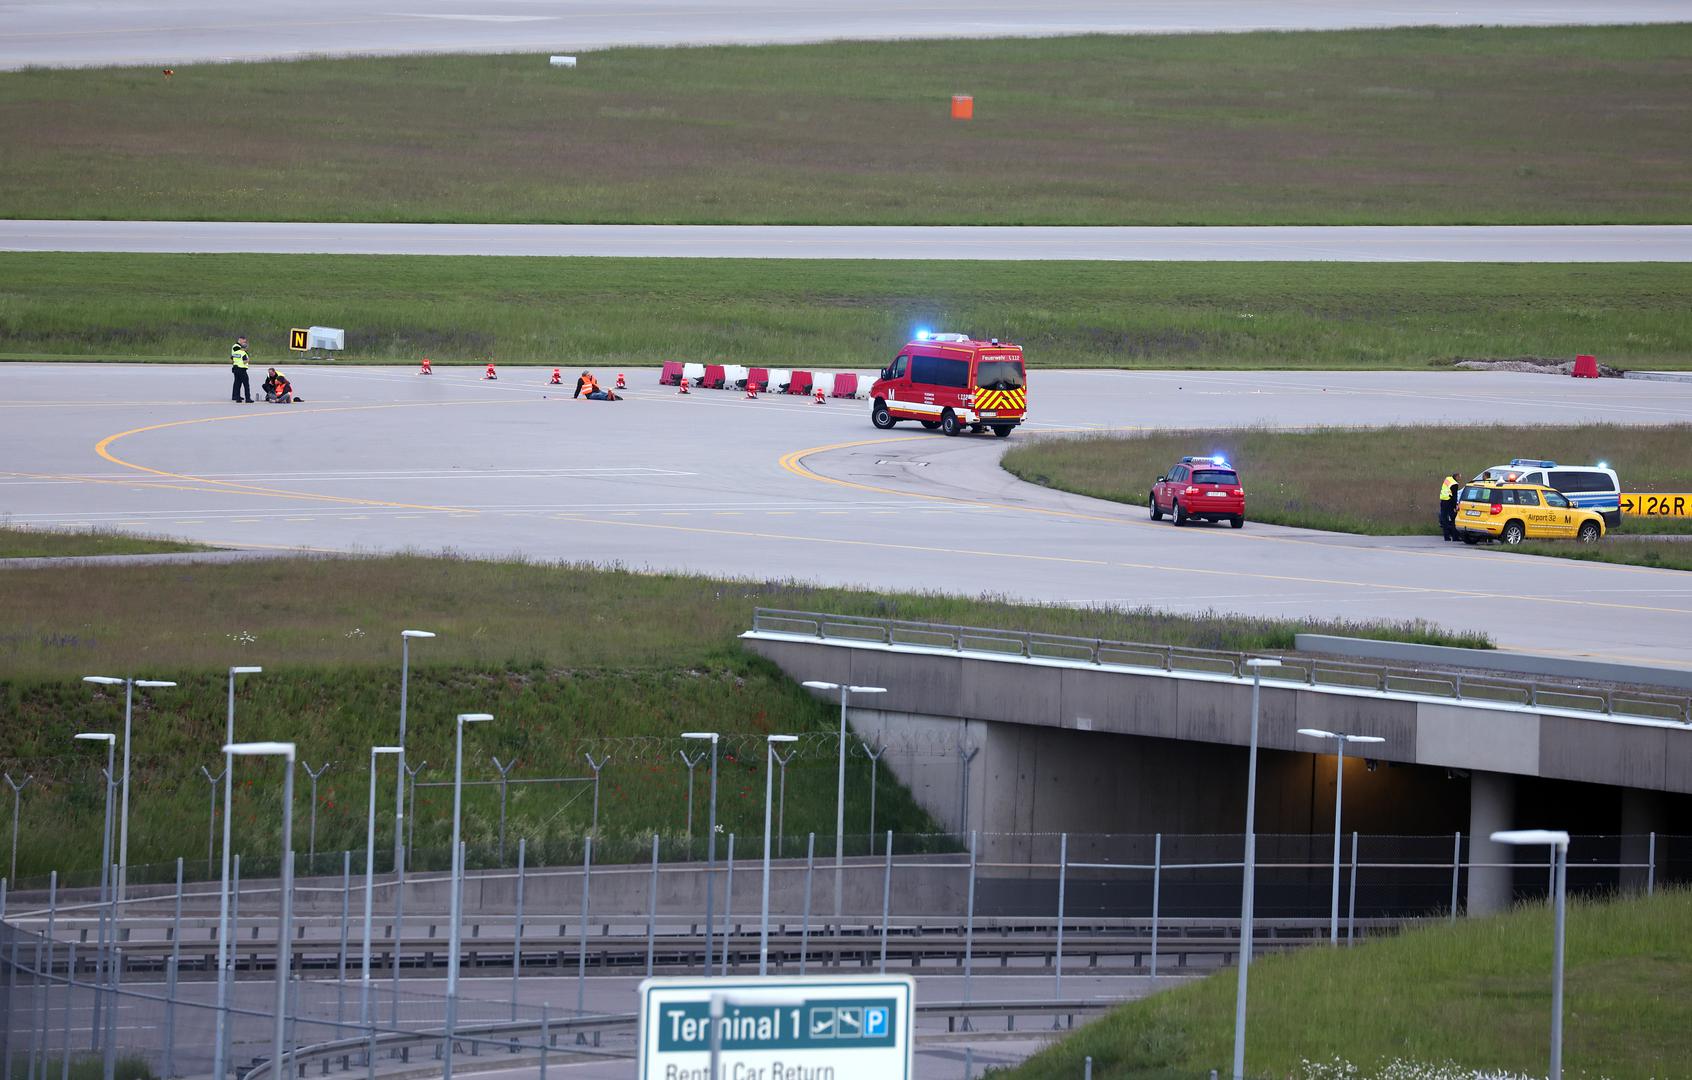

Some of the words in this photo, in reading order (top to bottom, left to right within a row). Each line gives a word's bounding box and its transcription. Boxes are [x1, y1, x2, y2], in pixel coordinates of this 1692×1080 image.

[295, 332, 304, 347] N
[888, 388, 895, 400] M
[1647, 496, 1685, 515] 26R
[1528, 513, 1548, 522] Airport
[1549, 514, 1557, 522] 32
[1565, 515, 1572, 524] M
[790, 1008, 800, 1040] 1
[666, 1062, 727, 1080] Rentl
[733, 1061, 766, 1080] Car
[772, 1060, 835, 1080] Return
